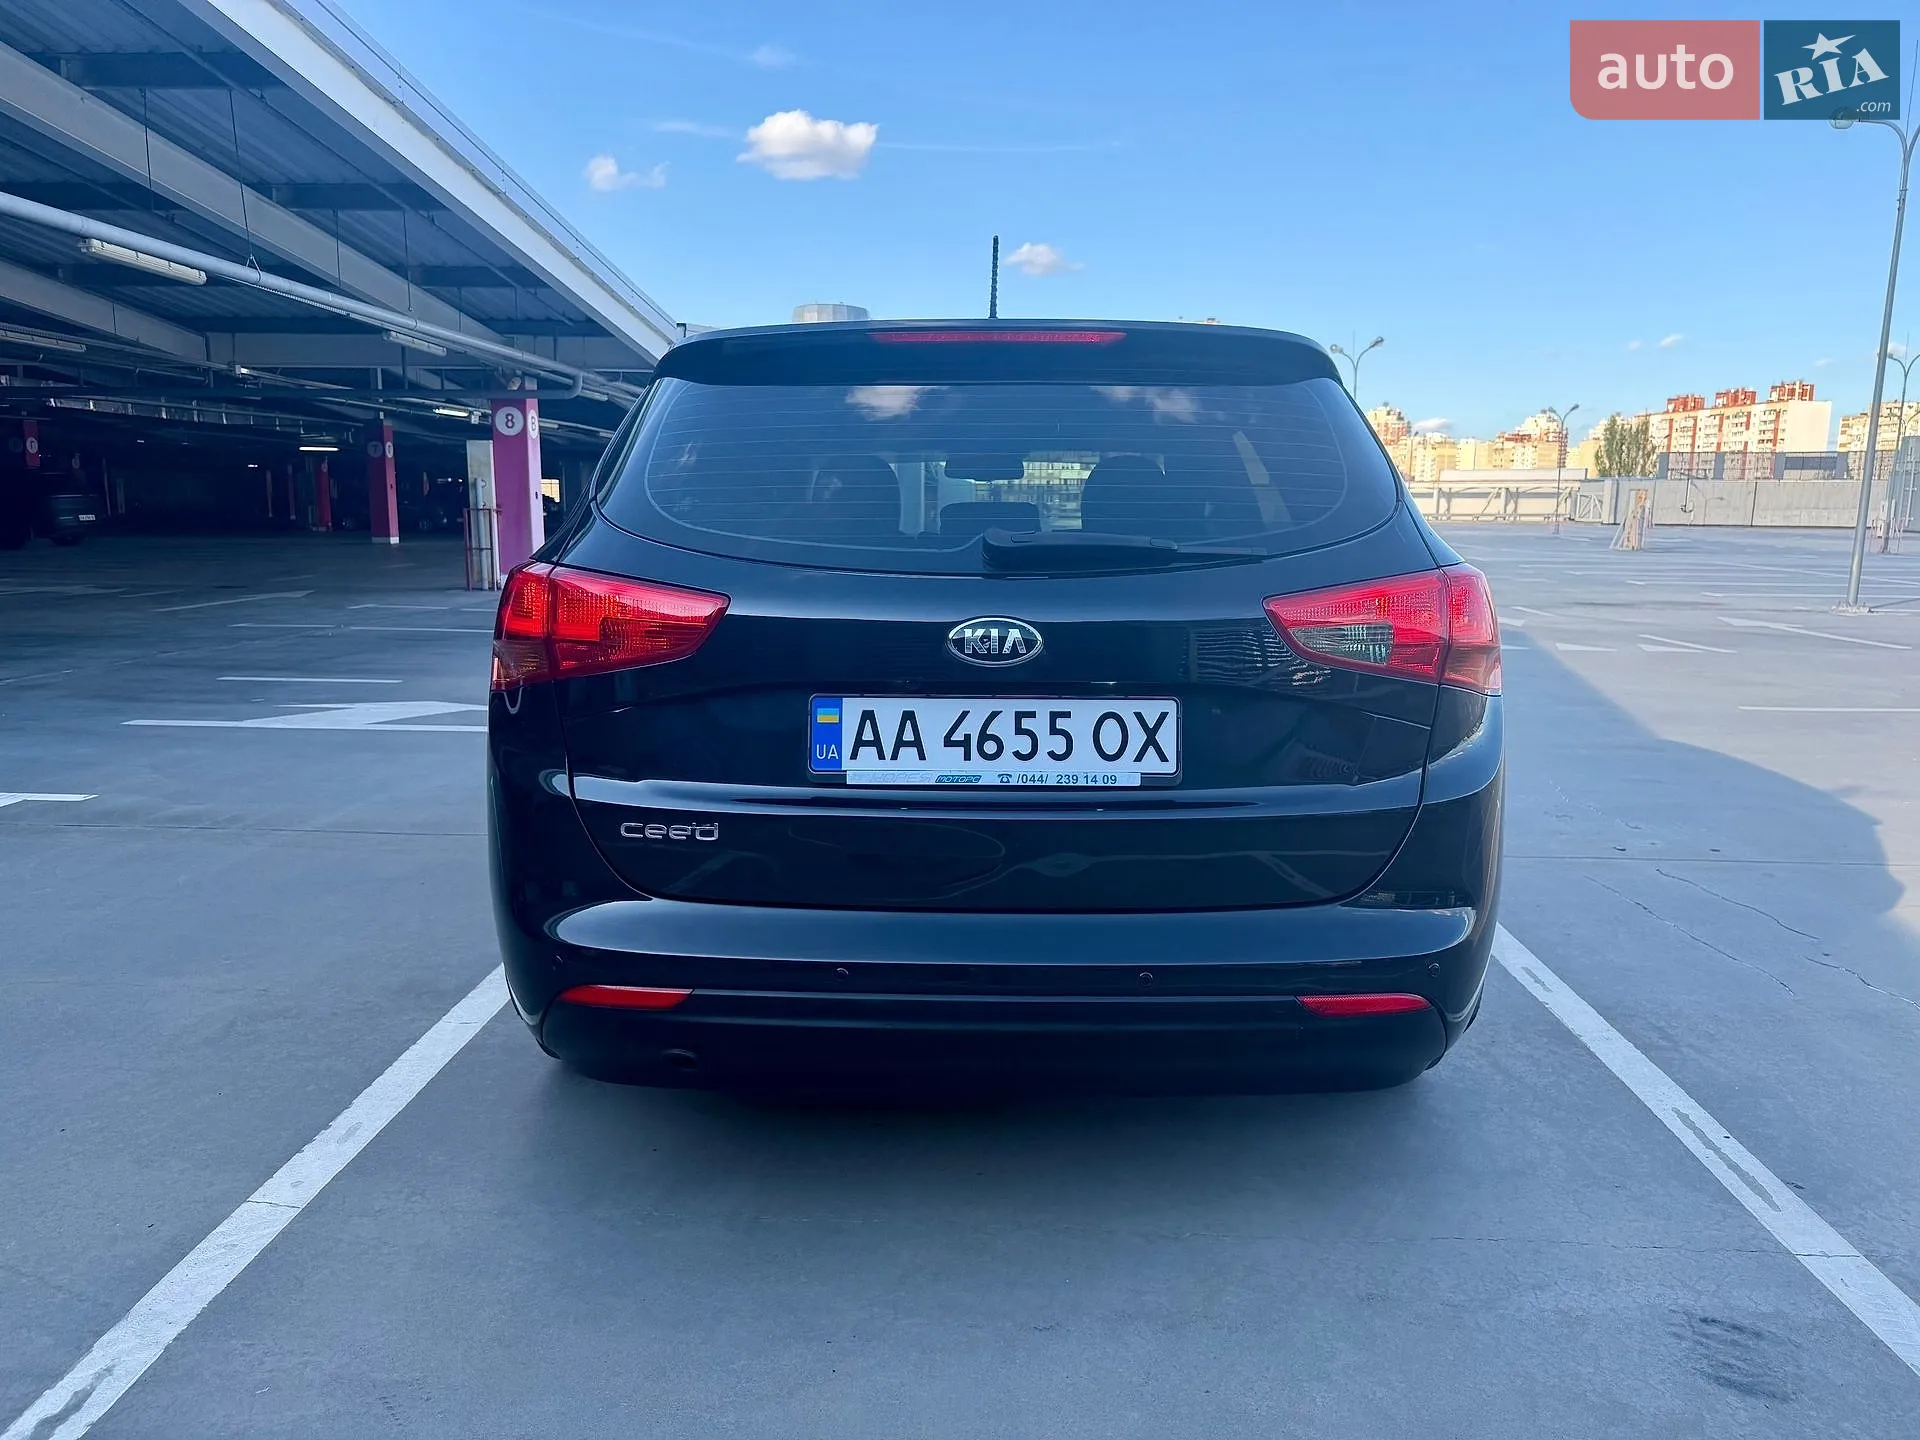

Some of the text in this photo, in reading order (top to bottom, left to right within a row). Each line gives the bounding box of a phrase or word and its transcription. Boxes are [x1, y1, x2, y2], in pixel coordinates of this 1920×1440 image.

[504, 412, 515, 429] 8
[964, 627, 1027, 655] KIA
[849, 709, 1170, 763] AA 4655 OX
[815, 744, 839, 760] UA
[1016, 773, 1049, 785] /044/
[1056, 774, 1079, 785] 239
[1083, 774, 1100, 785] 14
[1102, 774, 1118, 785] 09
